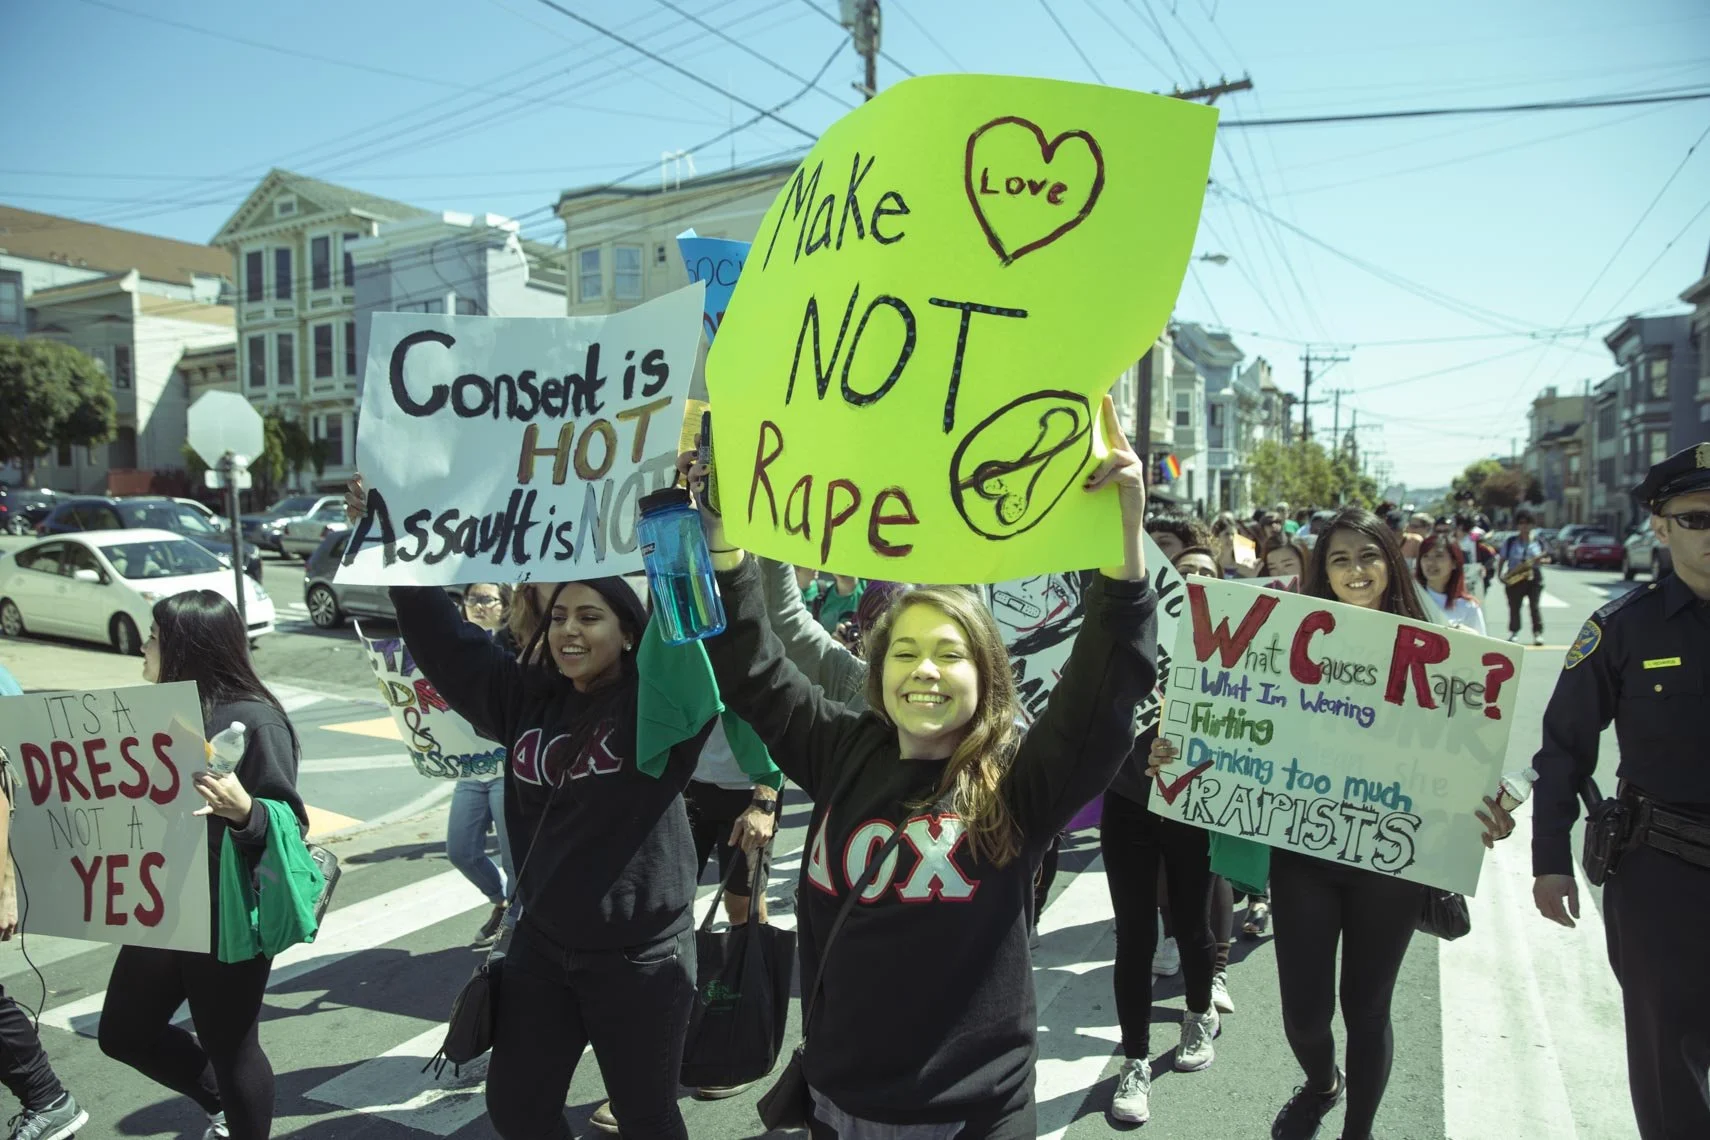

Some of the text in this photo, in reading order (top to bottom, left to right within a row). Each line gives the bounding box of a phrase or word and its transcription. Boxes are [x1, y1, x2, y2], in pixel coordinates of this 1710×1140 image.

[980, 167, 1068, 204] Love
[389, 330, 670, 422] Consent is
[785, 281, 1029, 434] NOT
[517, 396, 673, 485] HOT
[341, 488, 542, 570] Assault
[539, 505, 574, 565] is
[748, 420, 920, 565] Rape
[1186, 583, 1285, 674] What
[1289, 610, 1379, 687] Causes
[1384, 624, 1515, 720] Rape?
[112, 691, 136, 733] A
[1190, 702, 1274, 745] Flirting
[1201, 667, 1251, 702] What
[1300, 688, 1376, 728] Wearing
[20, 732, 180, 806] DRESS
[1186, 737, 1274, 786] Drinking
[1282, 757, 1331, 795] too
[1343, 774, 1413, 812] much
[47, 805, 144, 850] NOT A
[1182, 775, 1422, 875] RAPISTS
[70, 852, 166, 927] YES
